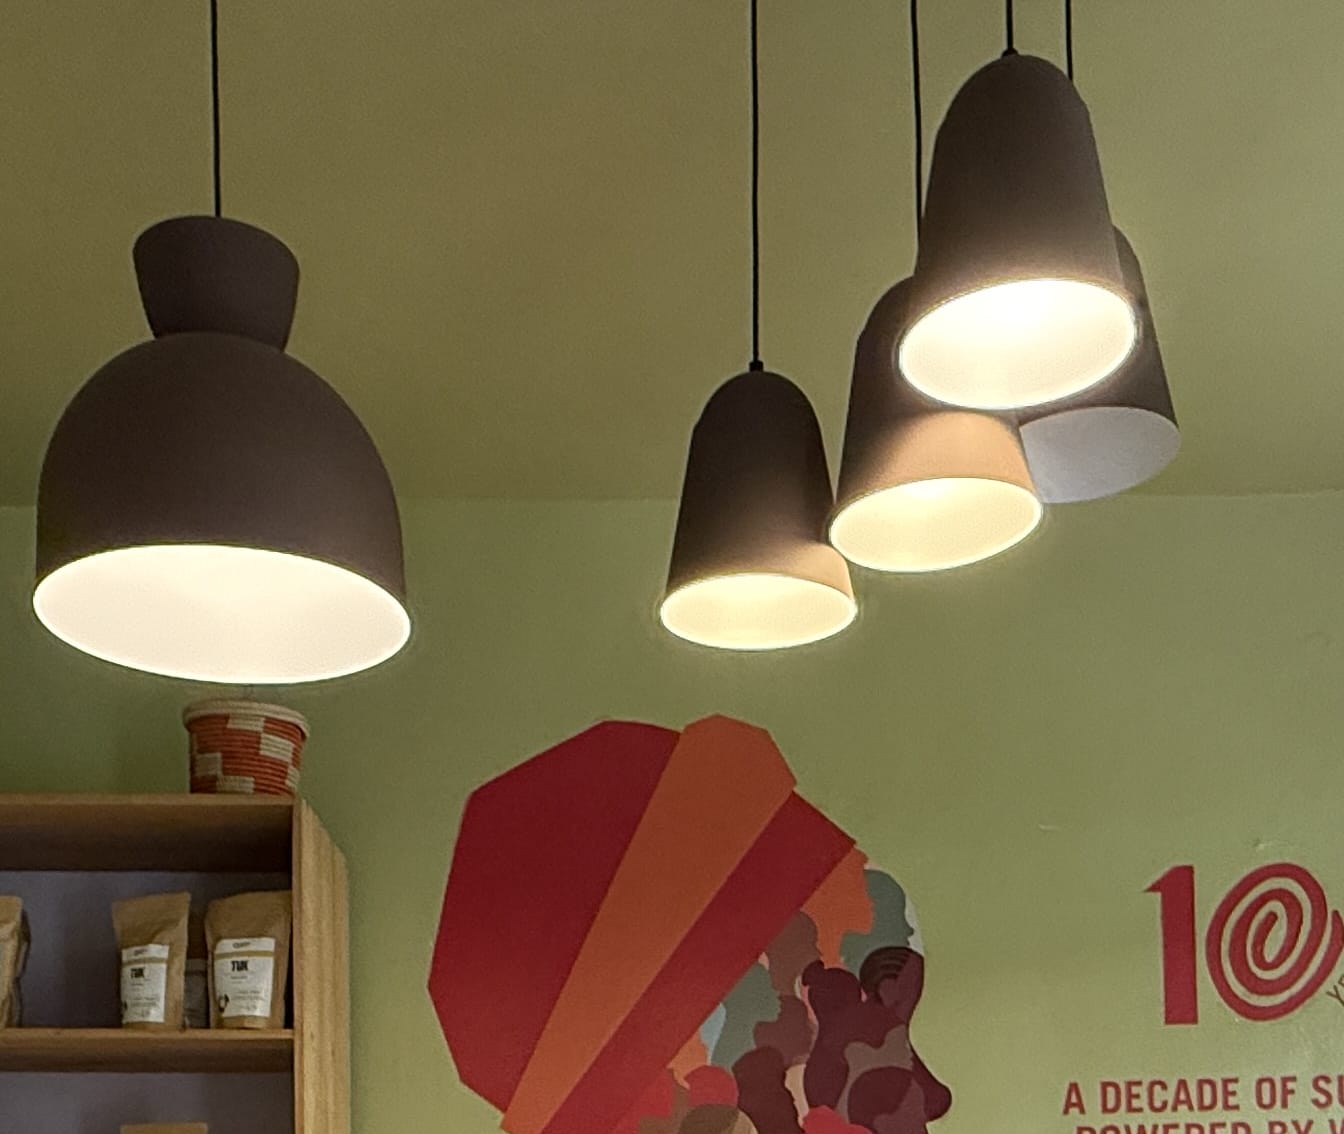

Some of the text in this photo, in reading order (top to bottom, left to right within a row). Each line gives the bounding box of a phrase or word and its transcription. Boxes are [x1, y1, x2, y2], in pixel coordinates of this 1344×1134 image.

[1062, 1082, 1086, 1116] A
[1100, 1077, 1240, 1115] DECADE
[1256, 1075, 1297, 1111] OF
